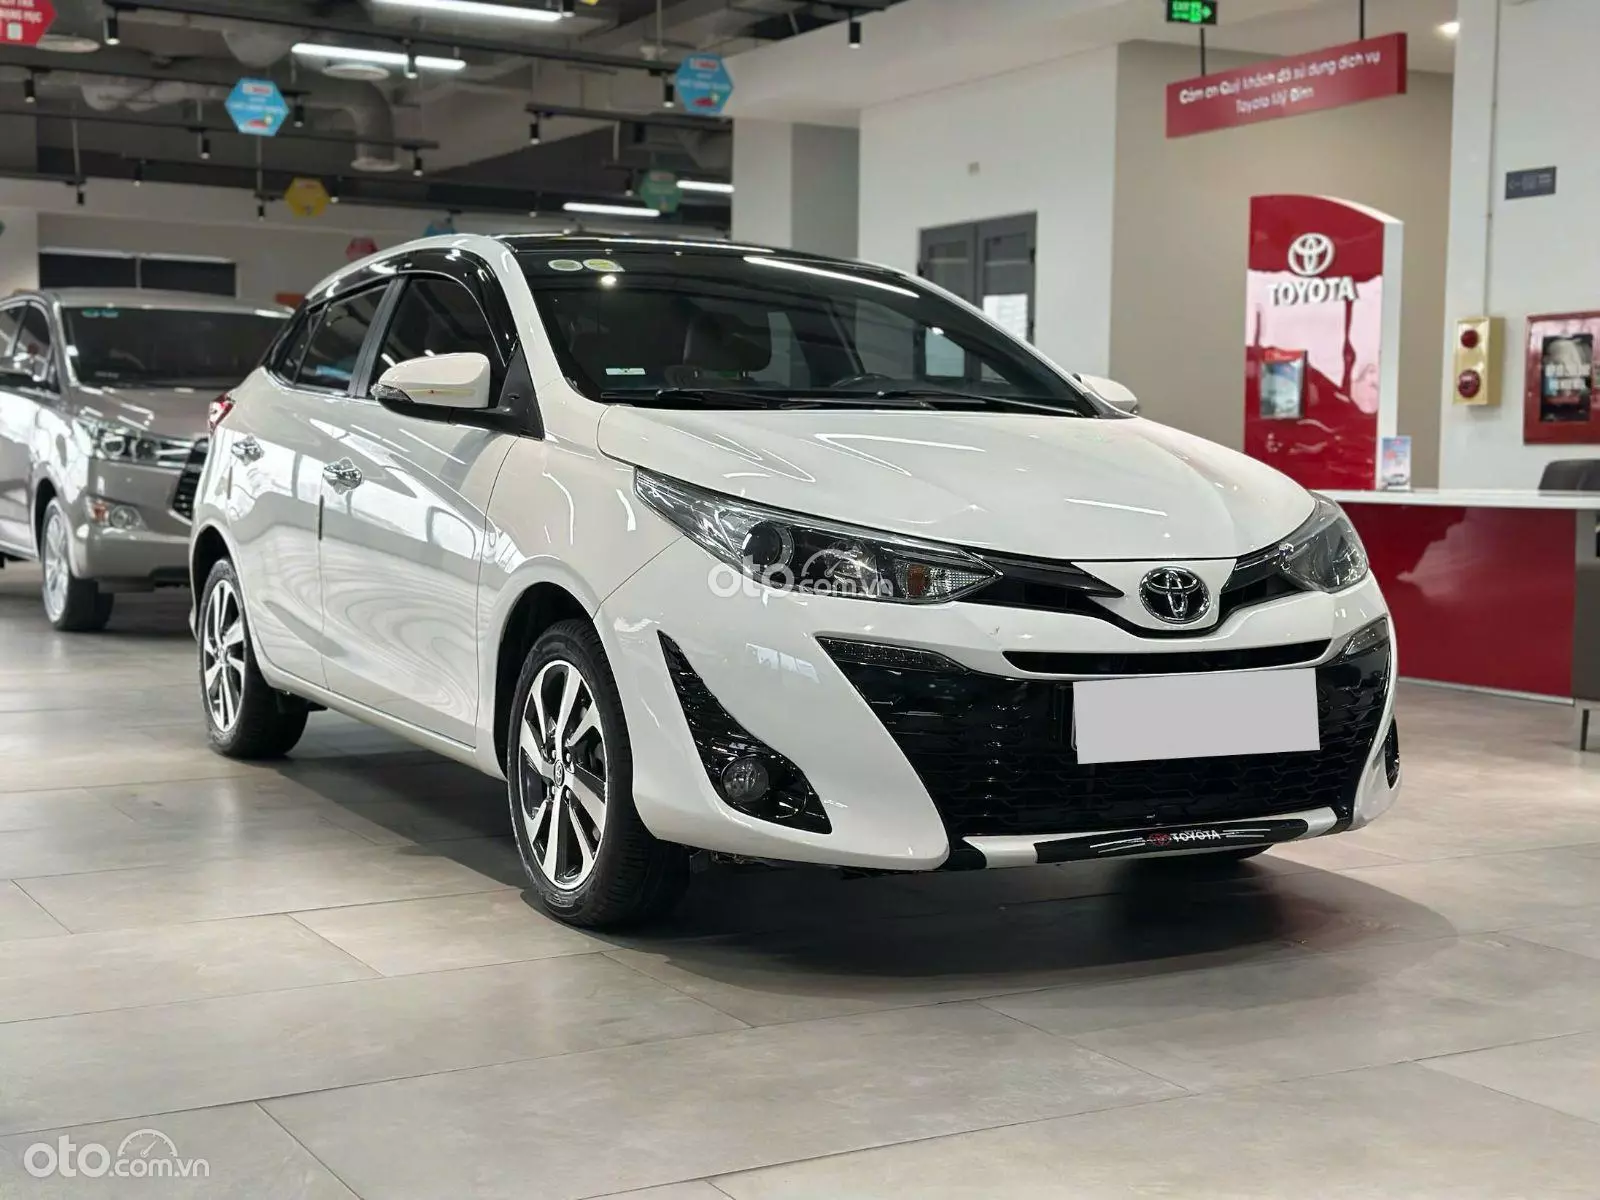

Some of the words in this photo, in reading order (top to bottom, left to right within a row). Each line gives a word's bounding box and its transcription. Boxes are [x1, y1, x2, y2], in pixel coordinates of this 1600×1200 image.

[1236, 96, 1269, 114] Toyota
[1268, 276, 1358, 306] TOYOTA
[1170, 829, 1221, 843] TOYOTA
